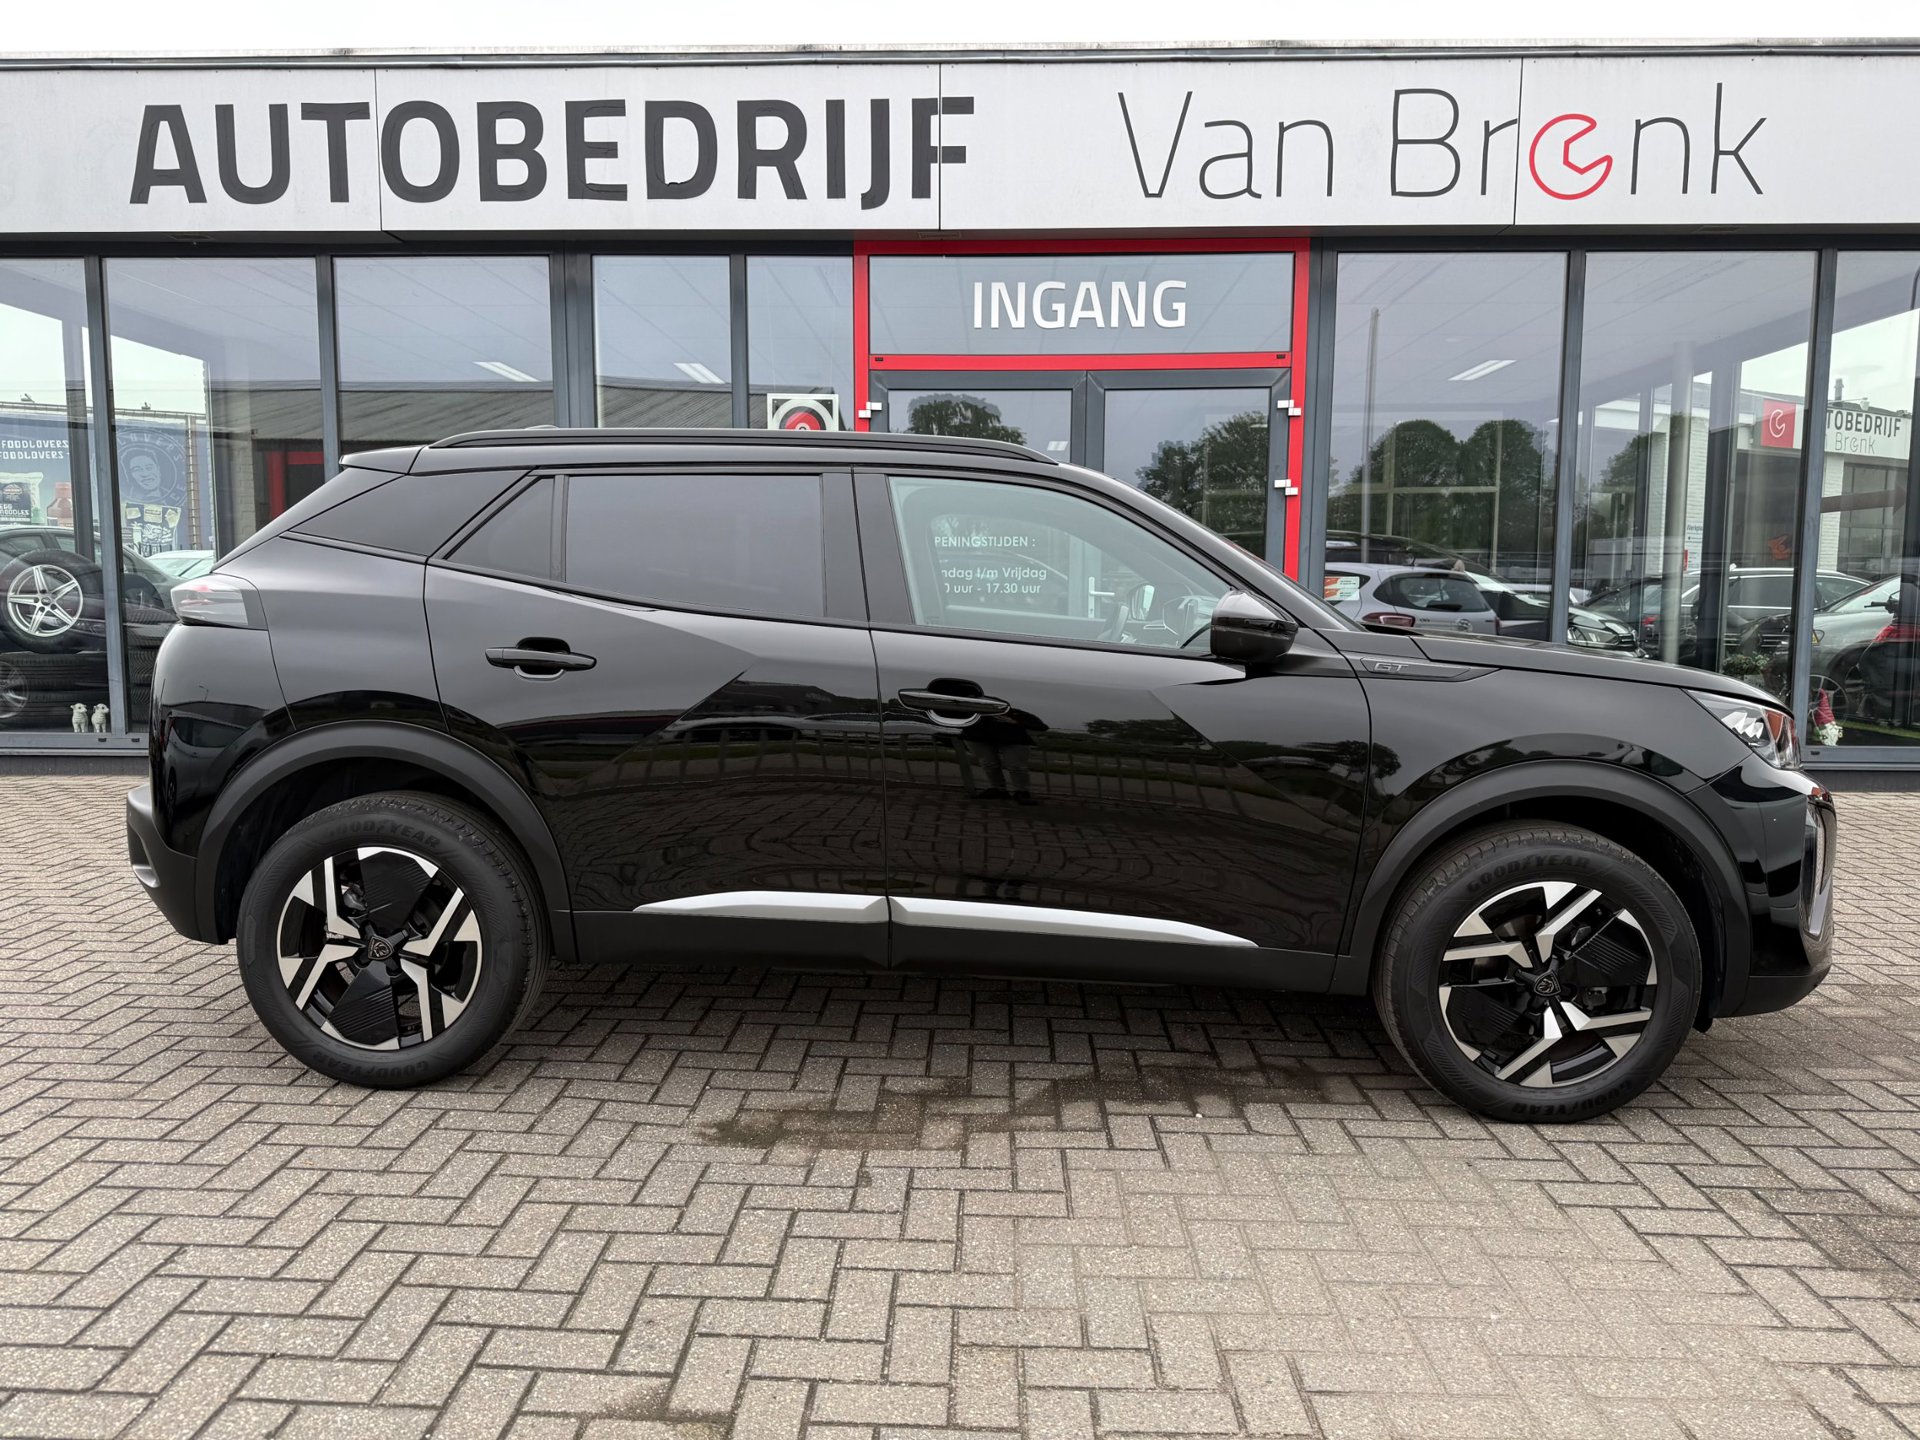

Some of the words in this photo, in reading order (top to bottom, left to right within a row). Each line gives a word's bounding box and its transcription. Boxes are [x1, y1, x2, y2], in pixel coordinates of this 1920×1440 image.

[1118, 91, 1334, 200] Van
[130, 96, 975, 210] AUTOBEDRIJF
[973, 280, 1187, 329] INGANG
[1827, 410, 1901, 438] TOBEDRIJF
[1, 440, 69, 449] FOODLOVERS
[934, 536, 1028, 547] PENINGSTIJDEN
[941, 567, 973, 580] ndag
[1002, 567, 1047, 580] Vrijdag
[954, 584, 973, 594] uur
[986, 583, 1018, 594] 17.30
[1021, 584, 1041, 594] uur
[1373, 661, 1409, 673] GT
